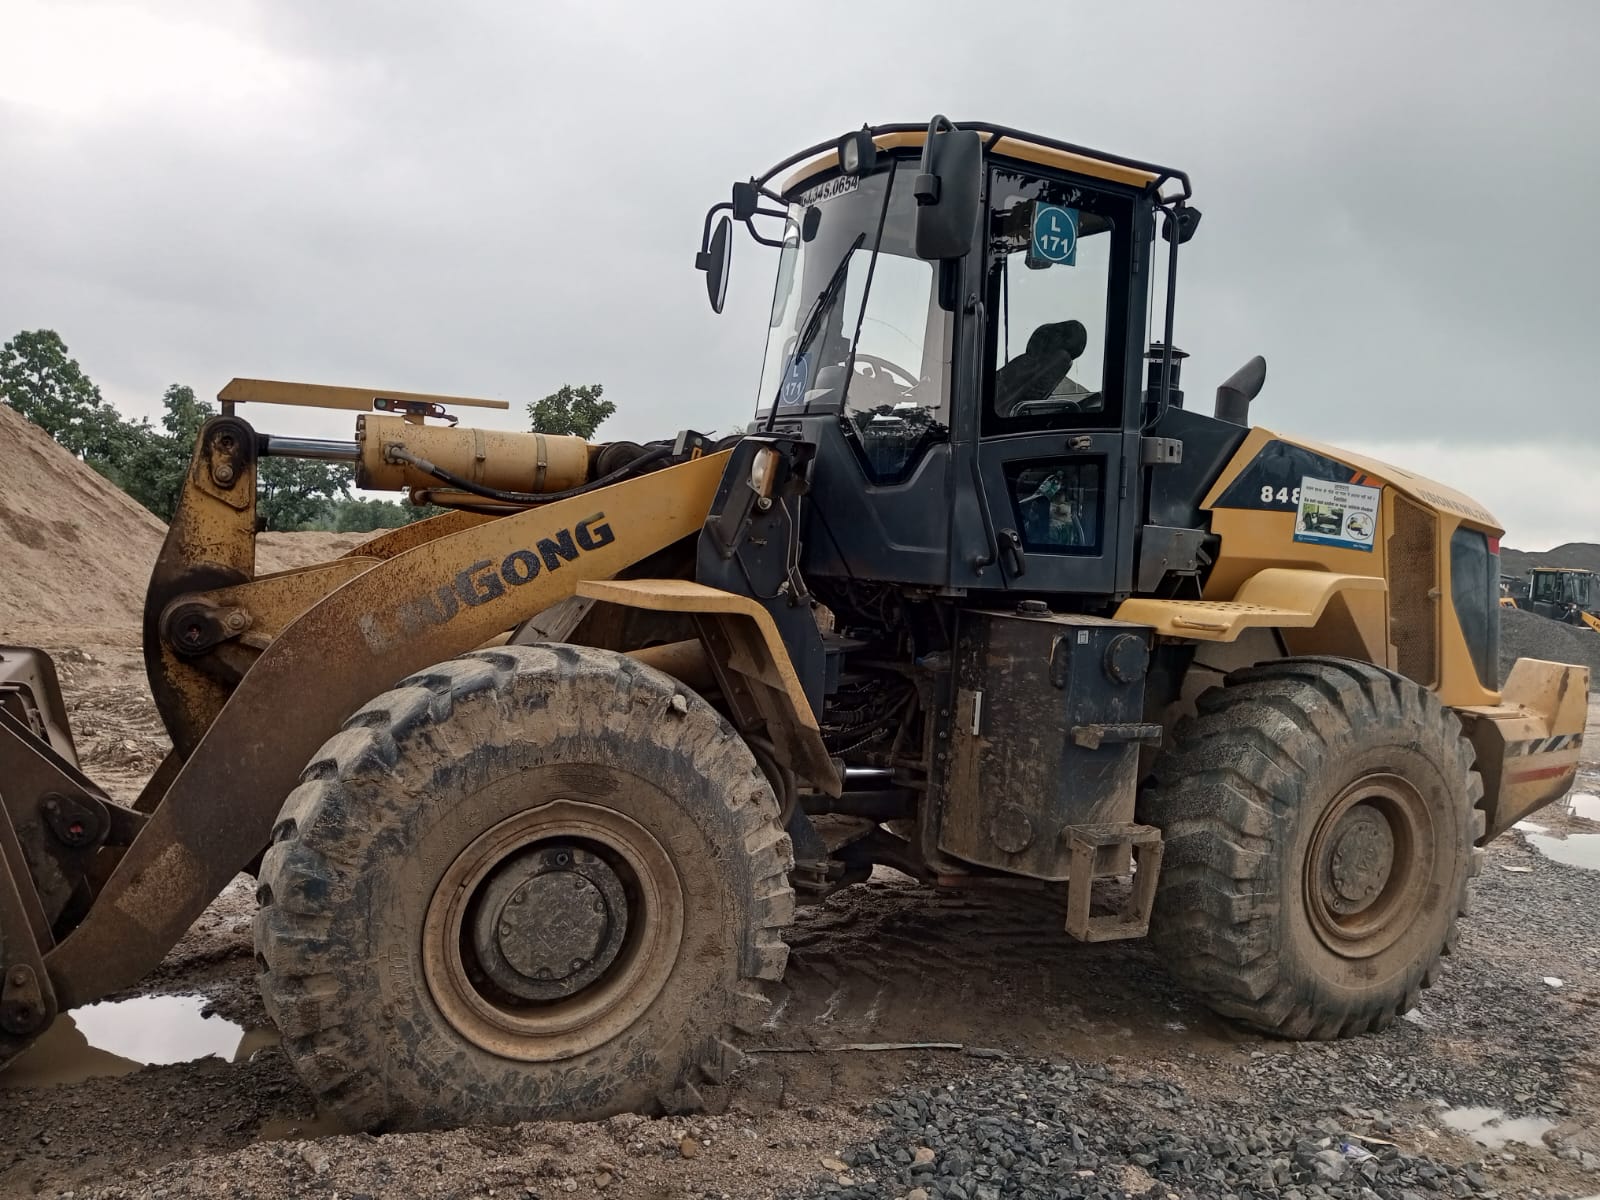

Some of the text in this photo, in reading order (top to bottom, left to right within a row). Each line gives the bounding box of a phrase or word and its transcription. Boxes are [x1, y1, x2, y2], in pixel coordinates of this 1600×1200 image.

[1051, 215, 1061, 233] L
[1040, 234, 1069, 254] 171
[792, 365, 798, 378] L
[785, 381, 802, 396] 171
